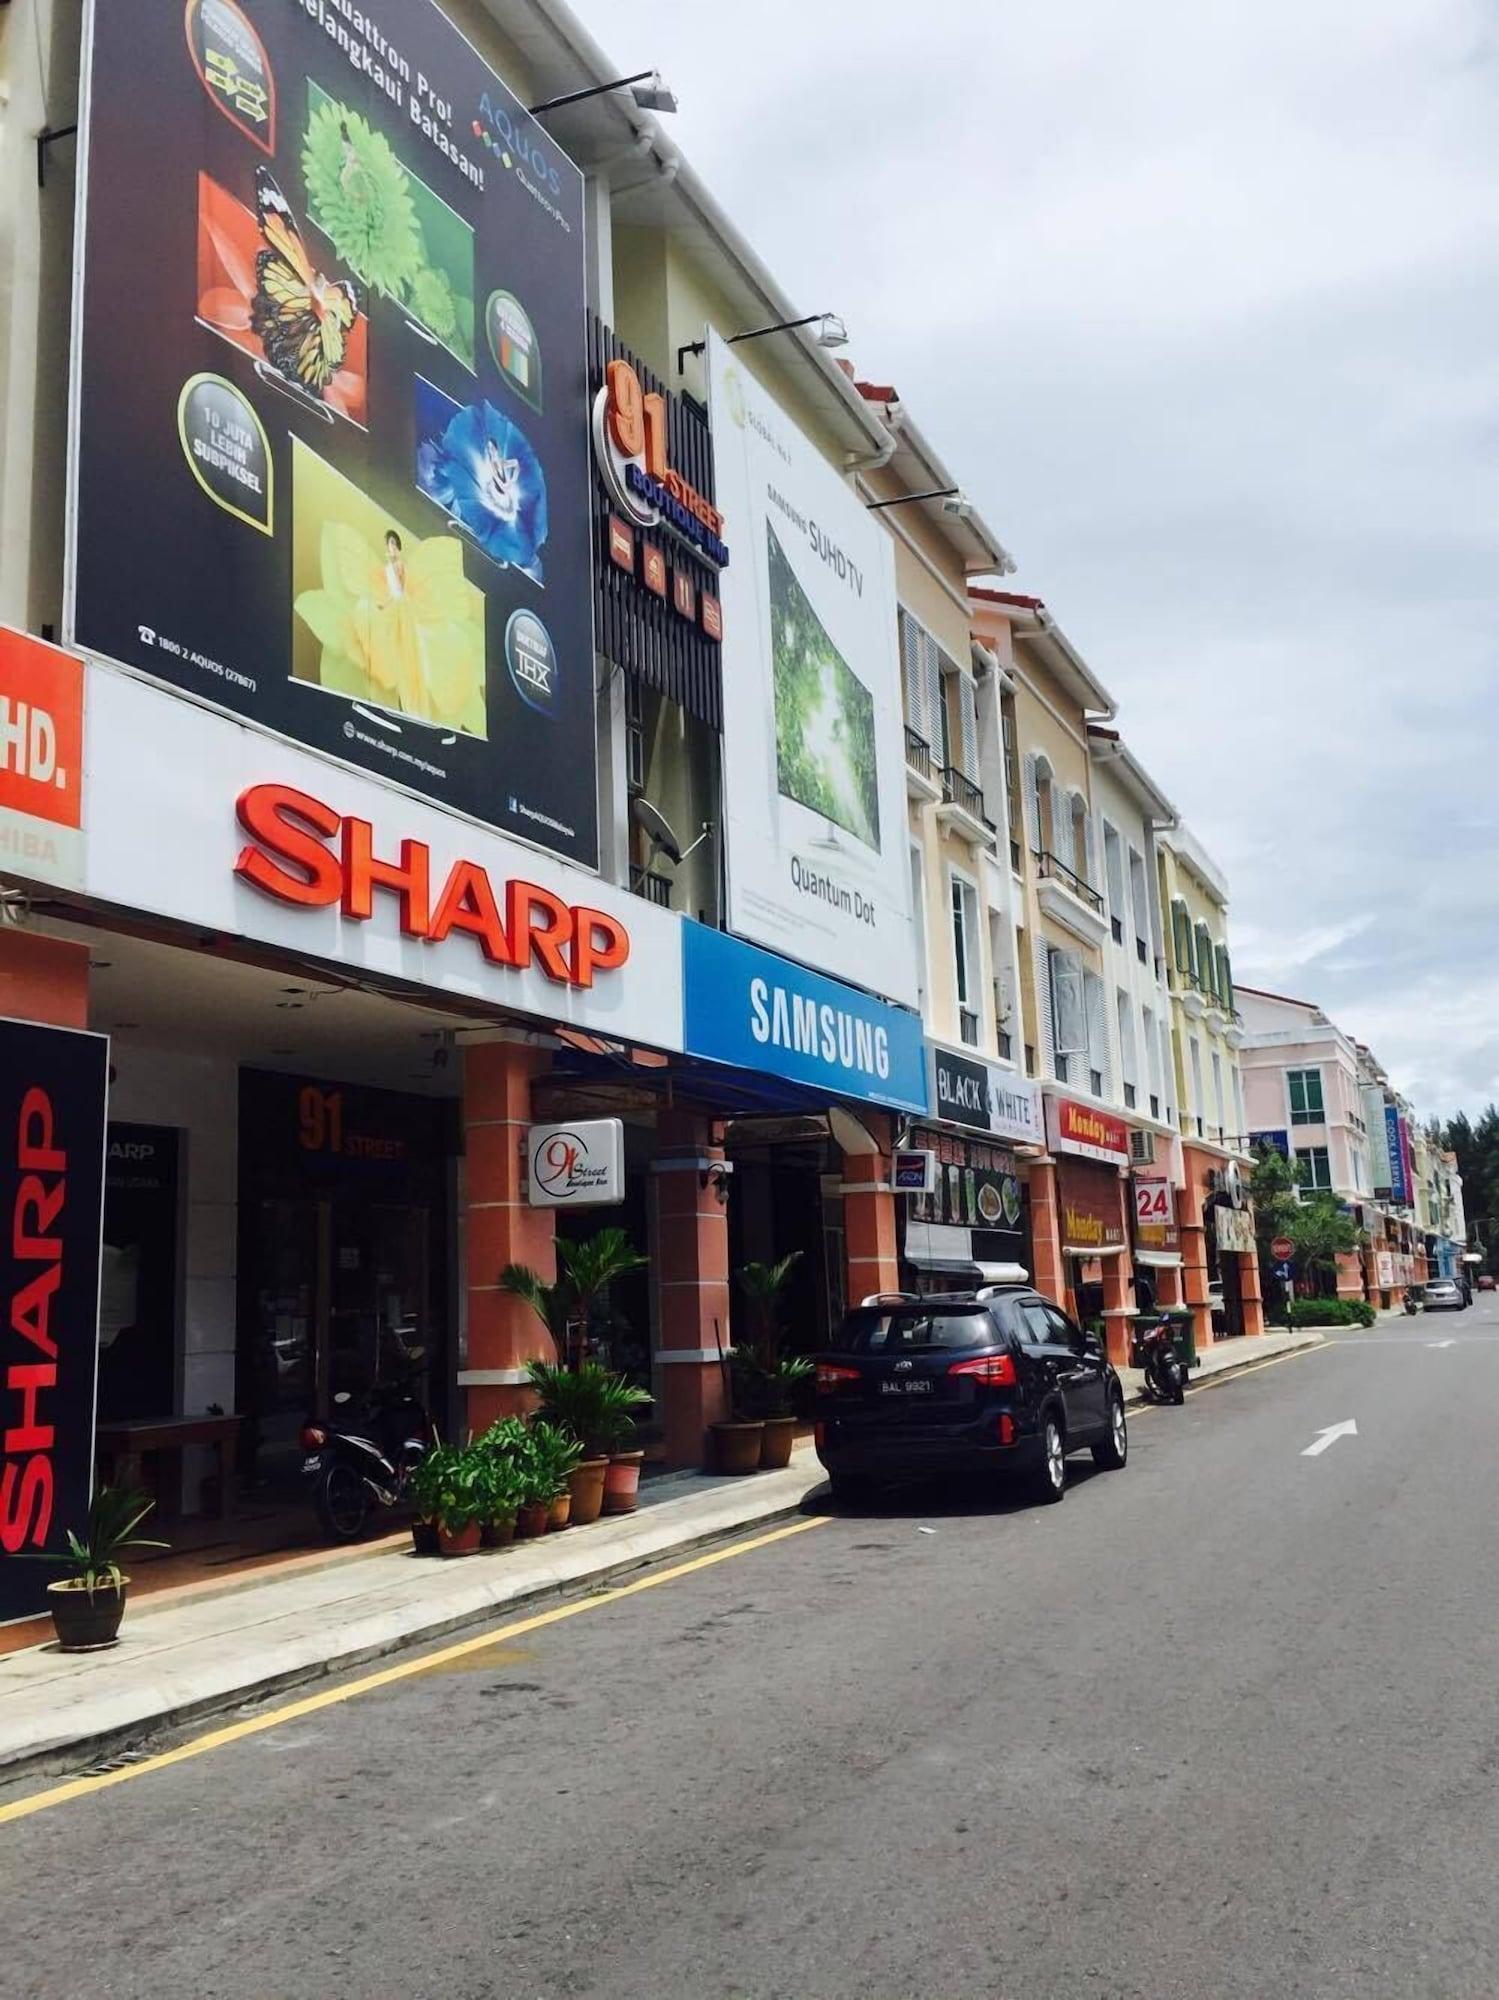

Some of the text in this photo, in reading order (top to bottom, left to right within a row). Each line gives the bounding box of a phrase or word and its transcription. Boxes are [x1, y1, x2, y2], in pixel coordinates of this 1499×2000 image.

[331, 0, 410, 82] uattron
[417, 72, 453, 128] Pro!
[301, 0, 402, 106] elangkaui
[410, 96, 485, 191] Batasan!
[204, 407, 253, 450] 10 JUTA
[211, 429, 247, 465] LEBIH
[607, 359, 668, 483] 91
[193, 438, 262, 494] SUBPIKSEL
[664, 468, 725, 541] STREET
[767, 484, 864, 599] SAMSUNG SUHD TV
[158, 636, 181, 655] 1800
[182, 646, 193, 660] 2
[190, 652, 224, 676] AQUOS
[515, 648, 551, 693] THX
[234, 783, 631, 989] SHARP
[791, 856, 851, 914] Quantum
[854, 892, 876, 928] Dot
[750, 977, 890, 1081] SAMSUNG
[300, 1086, 343, 1152] 91
[938, 1067, 982, 1112] BLACK
[995, 1087, 1031, 1125] WHITE
[1068, 1107, 1106, 1145] Monday
[344, 1136, 406, 1159] STREET
[573, 1163, 608, 1179] Street
[1137, 1189, 1168, 1216] 24
[0, 1087, 66, 1554] SHARP
